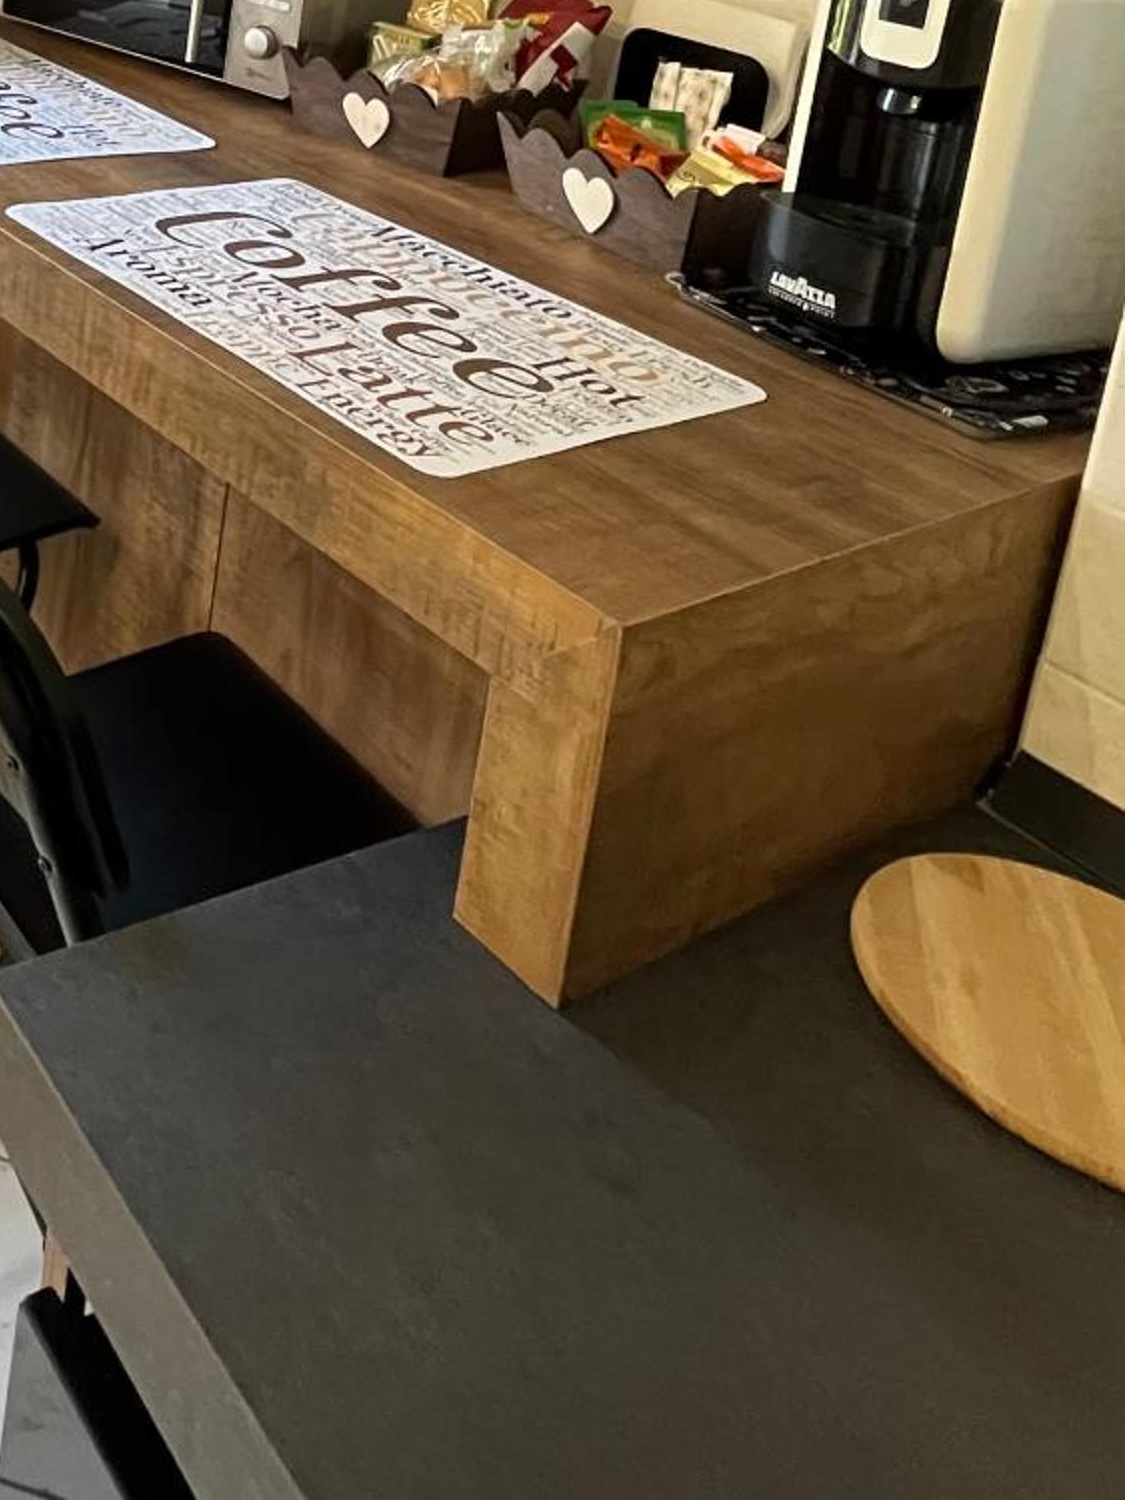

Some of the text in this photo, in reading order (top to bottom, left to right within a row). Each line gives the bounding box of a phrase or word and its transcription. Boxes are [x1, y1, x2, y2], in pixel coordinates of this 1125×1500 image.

[75, 238, 212, 307] Aroma
[137, 245, 321, 339] Espresso
[155, 211, 555, 400] Coffee
[230, 271, 344, 331] Mocha
[369, 226, 573, 319] Macchiato
[288, 342, 494, 445] Latte
[298, 379, 442, 457] Energy
[531, 356, 645, 408] Hot
